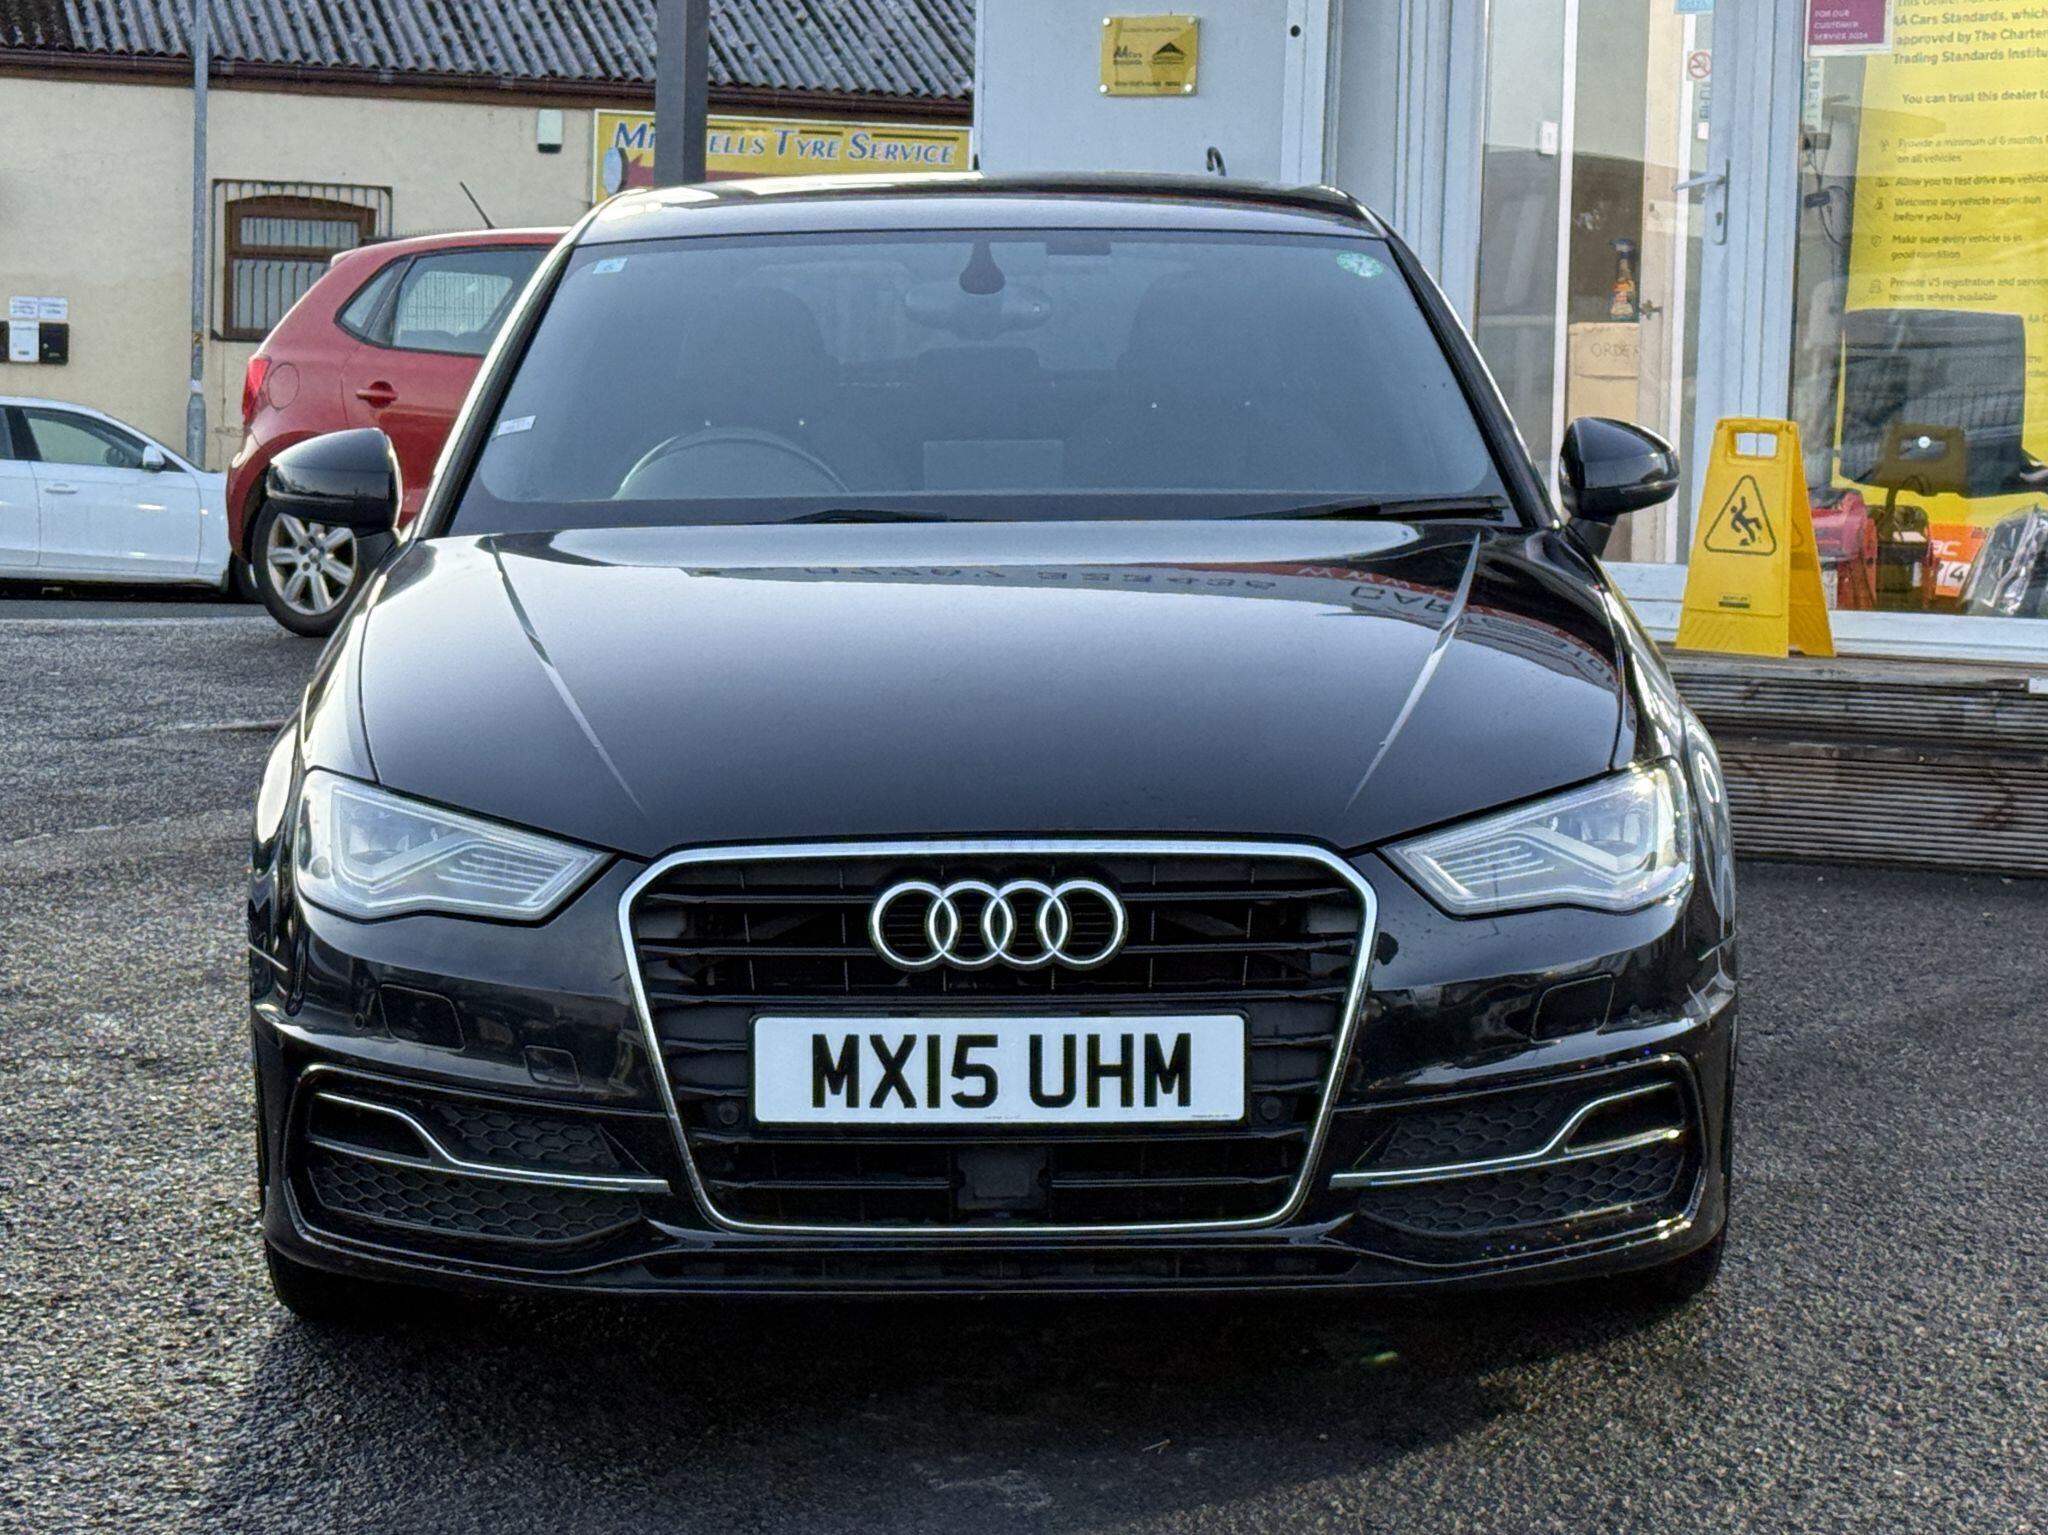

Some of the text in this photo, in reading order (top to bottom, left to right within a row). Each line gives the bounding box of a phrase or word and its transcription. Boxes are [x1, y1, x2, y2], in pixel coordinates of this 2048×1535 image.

[1910, 14, 1938, 25] Cars
[1942, 10, 2009, 24] Standards,
[1814, 21, 1859, 29] CUSTOMER
[1896, 32, 1955, 45] approved
[1957, 31, 1971, 44] by
[1975, 30, 1997, 41] The
[1893, 53, 1938, 66] Trading
[1942, 50, 2004, 62] Standards
[1902, 93, 1923, 104] You
[1925, 95, 1946, 103] can
[1949, 92, 1975, 103] trust
[1978, 91, 1999, 102] this
[2001, 90, 2037, 101] dealer
[1898, 138, 1934, 149] Provide
[1944, 138, 1986, 147] minimum
[1987, 136, 1998, 145] of
[2008, 134, 2043, 145] months
[1923, 178, 1941, 187] you
[1943, 177, 1951, 185] to
[1954, 176, 1973, 186] test
[1973, 175, 1997, 186] drive
[1958, 197, 1991, 207] vehicle
[1894, 212, 1962, 223] before you buy
[1968, 233, 2001, 243] vehicle
[812, 1032, 1192, 1109] MX15 UHM
